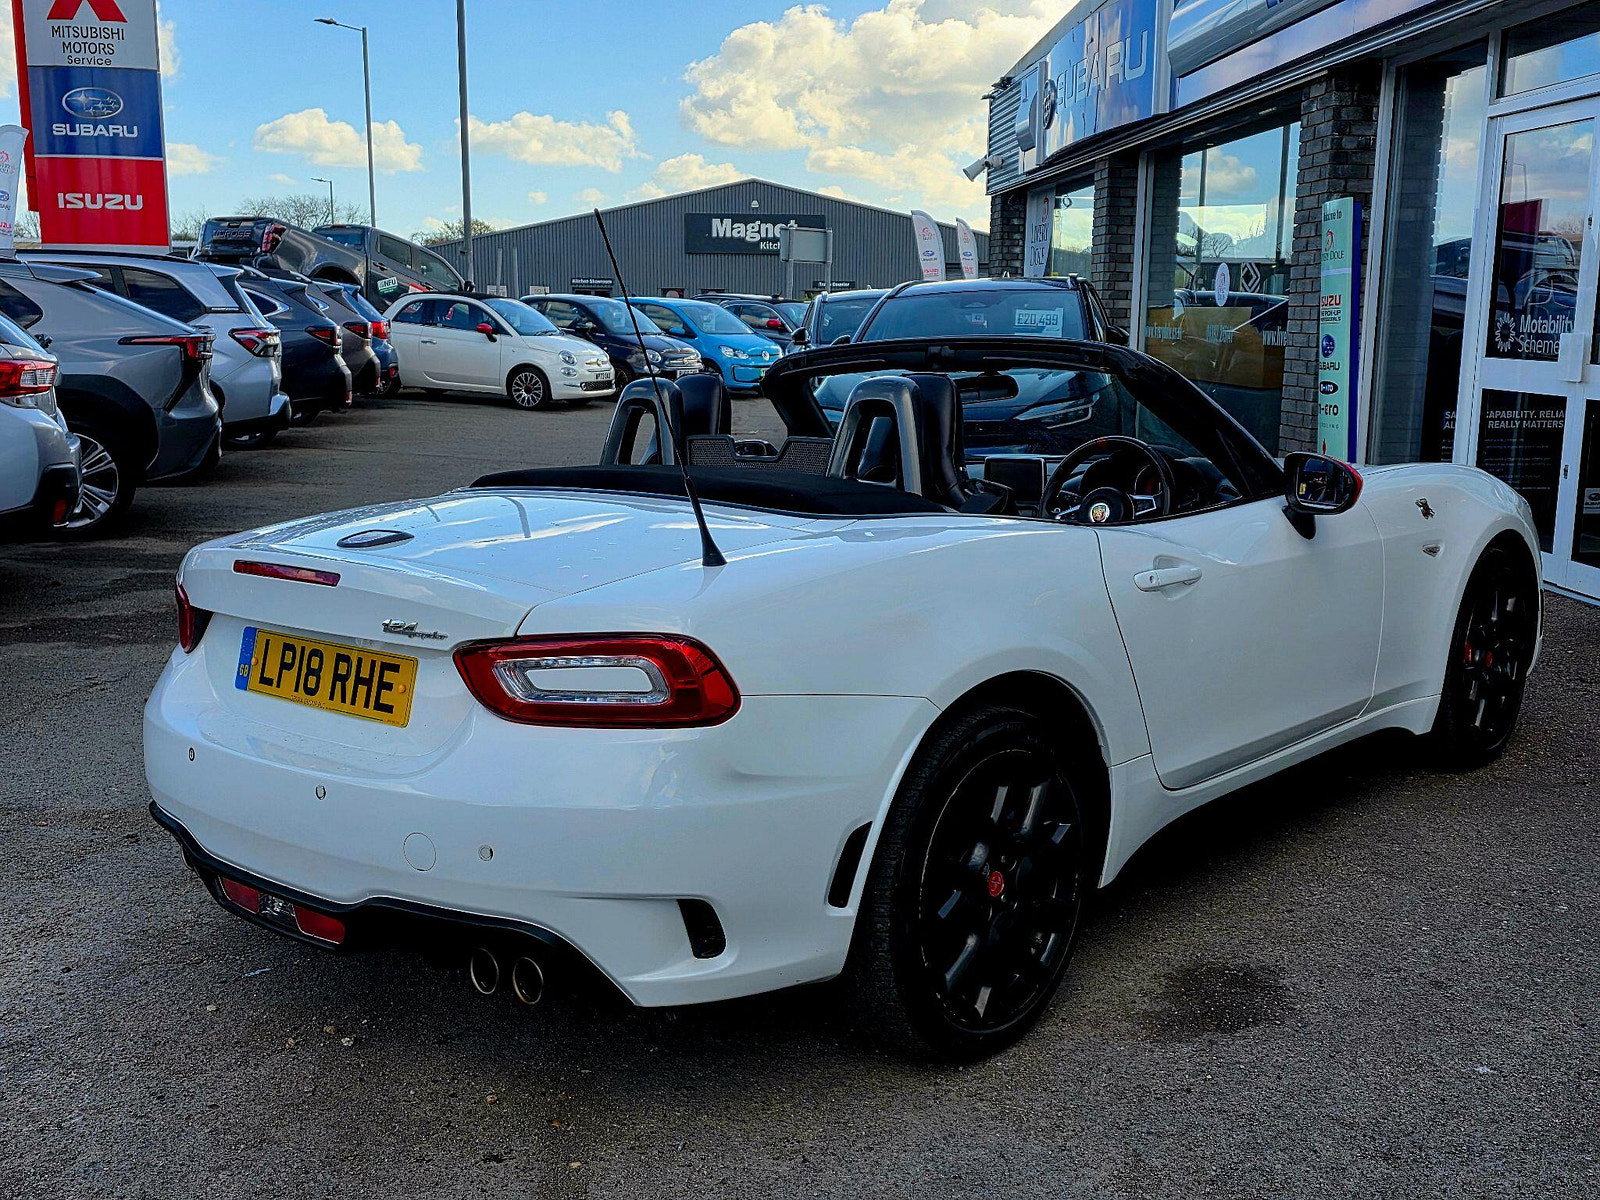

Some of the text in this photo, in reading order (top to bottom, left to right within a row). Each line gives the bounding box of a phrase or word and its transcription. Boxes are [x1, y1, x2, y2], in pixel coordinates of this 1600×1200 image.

[51, 25, 125, 41] MITSUBISHI
[62, 41, 115, 55] MOTORS
[67, 55, 112, 66] Service
[1056, 30, 1148, 109] SUBARU
[52, 123, 138, 138] SUBARU
[57, 192, 143, 210] ISUZU
[1017, 313, 1059, 327] £20,499
[1519, 314, 1575, 335] Motability
[1517, 334, 1560, 355] Scheme
[1488, 420, 1520, 429] REALLY
[1523, 420, 1564, 429] MATTERS
[239, 664, 249, 677] GB
[258, 638, 401, 715] LP18 RHE
